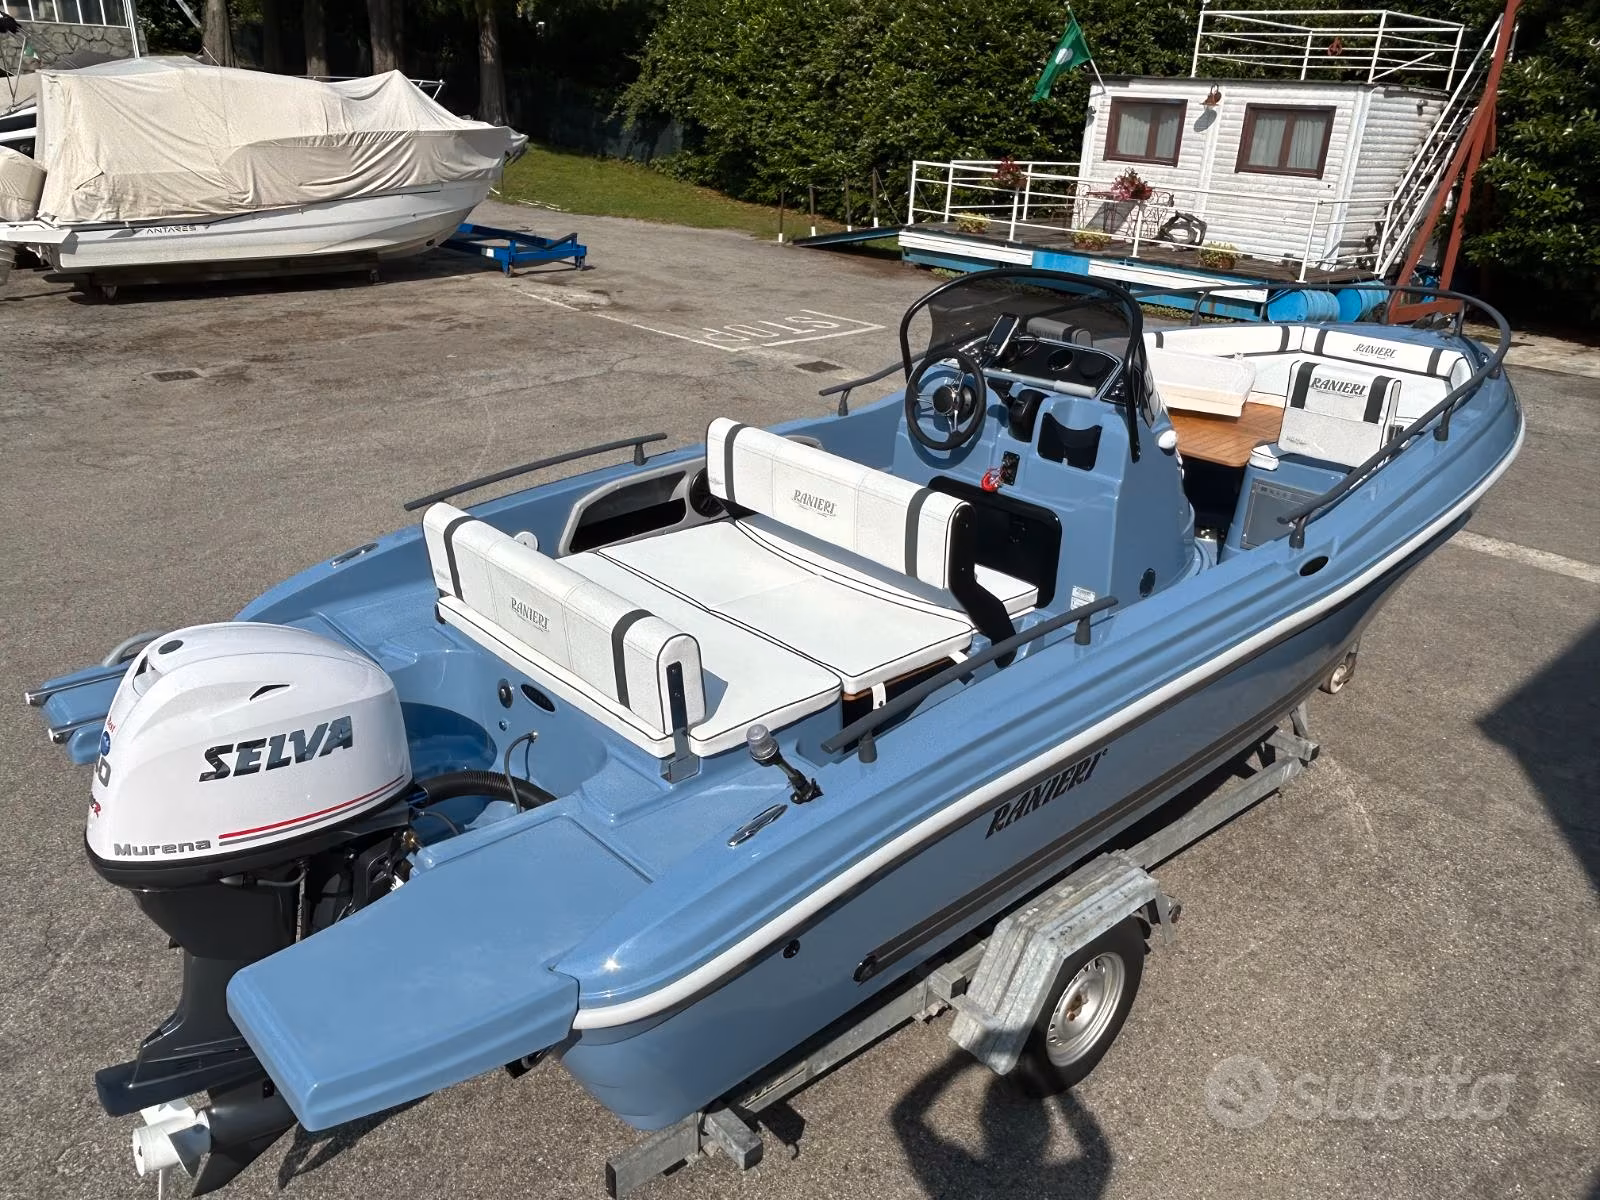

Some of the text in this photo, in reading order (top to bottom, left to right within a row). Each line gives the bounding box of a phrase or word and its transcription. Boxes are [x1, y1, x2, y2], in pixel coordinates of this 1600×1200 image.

[702, 316, 840, 342] STOP
[1353, 343, 1398, 359] RANIERI
[1311, 377, 1369, 397] RANIERI
[792, 489, 837, 516] RANIERI
[511, 597, 549, 631] RANIERI
[199, 715, 353, 782] SELVA
[985, 748, 1107, 840] RANIERI
[113, 840, 211, 856] Murena
